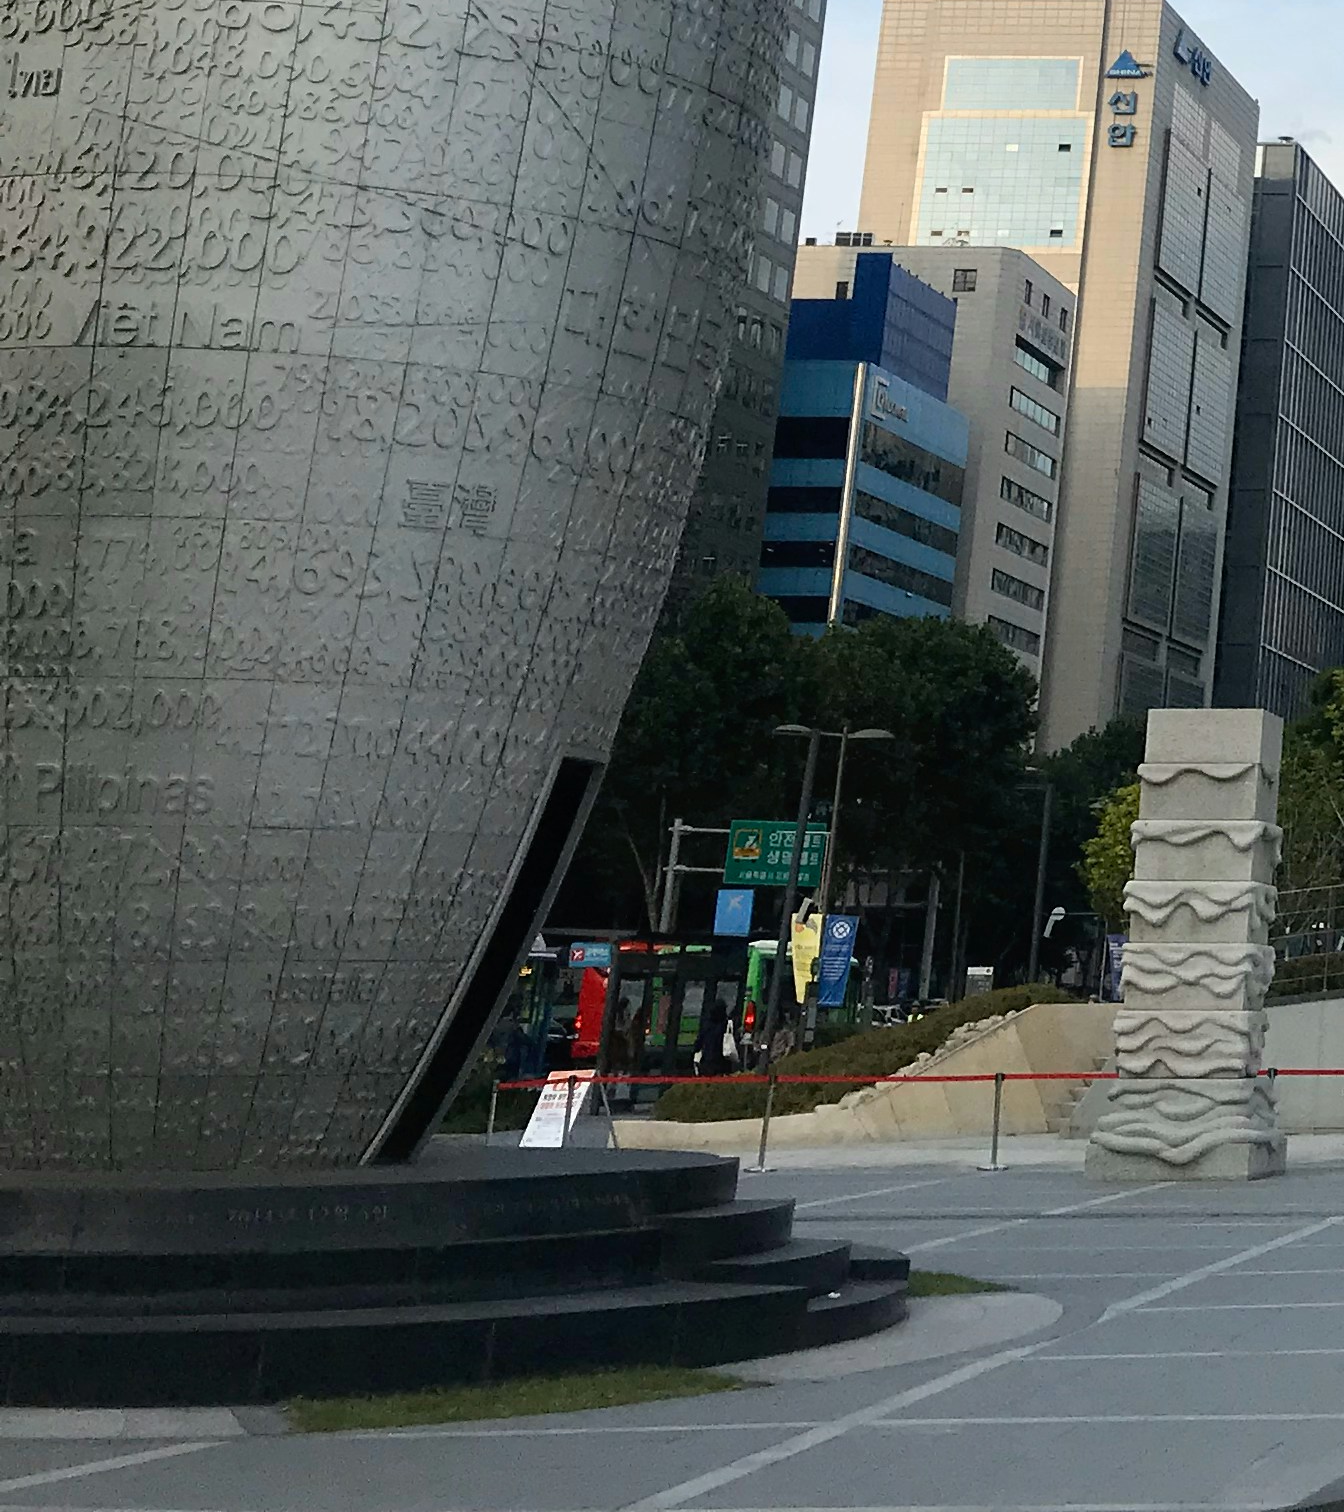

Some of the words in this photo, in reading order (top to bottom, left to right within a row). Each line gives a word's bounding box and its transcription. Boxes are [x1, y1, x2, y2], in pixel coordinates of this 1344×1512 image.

[8, 50, 63, 98] ไทย
[1107, 87, 1138, 148] 신안
[73, 299, 160, 359] Việt
[177, 302, 302, 353] Nam
[563, 285, 724, 373] 대한민국
[397, 477, 499, 538] 臺灣
[36, 763, 215, 818] Pilipinas
